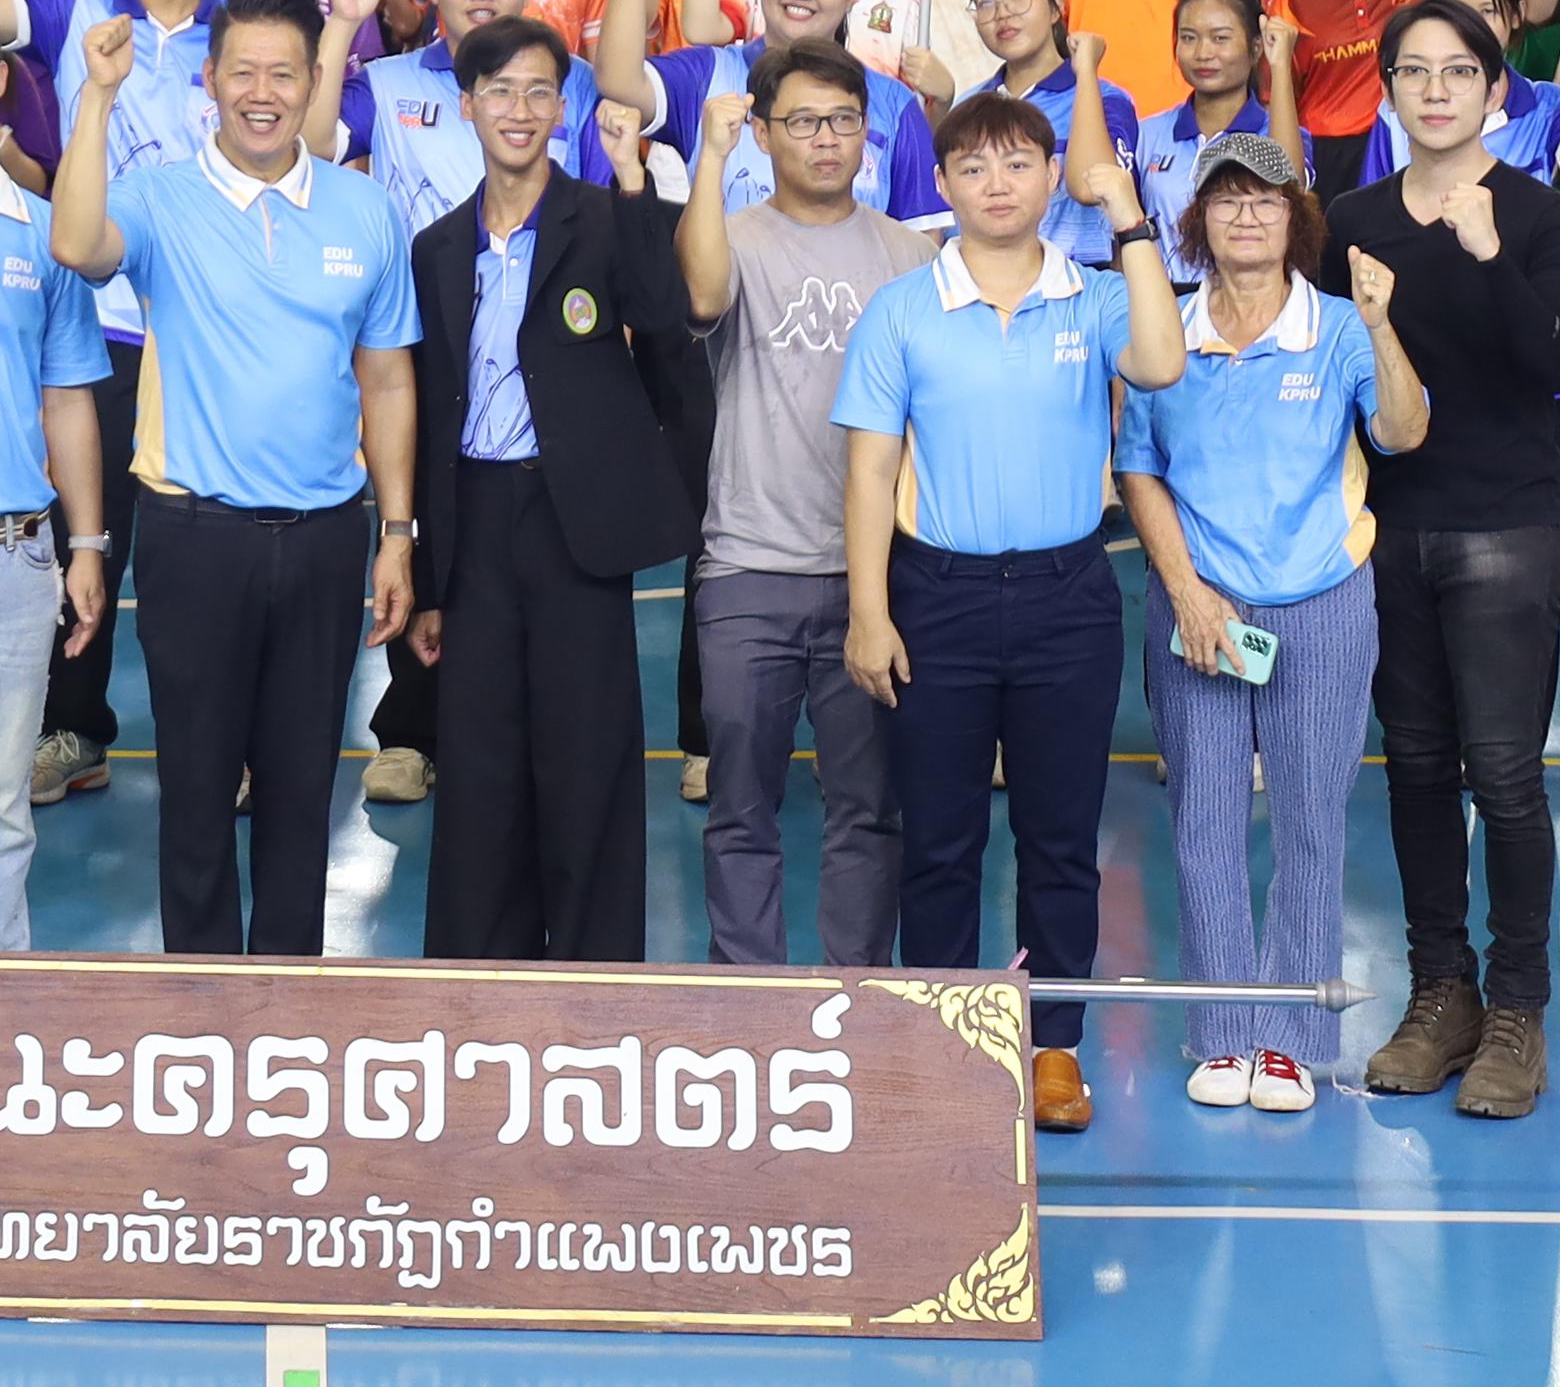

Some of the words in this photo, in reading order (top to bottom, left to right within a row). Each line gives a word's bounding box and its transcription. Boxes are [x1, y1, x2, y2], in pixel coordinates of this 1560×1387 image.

[1314, 38, 1379, 63] THAMM
[323, 245, 353, 262] EDU
[4, 255, 34, 275] EDU
[323, 260, 364, 279] KPRU
[2, 272, 41, 291] KPRU
[1053, 330, 1082, 347] EDU
[1053, 346, 1089, 363] KPRU
[1281, 372, 1315, 388] EDU
[1278, 386, 1322, 402] KPRU
